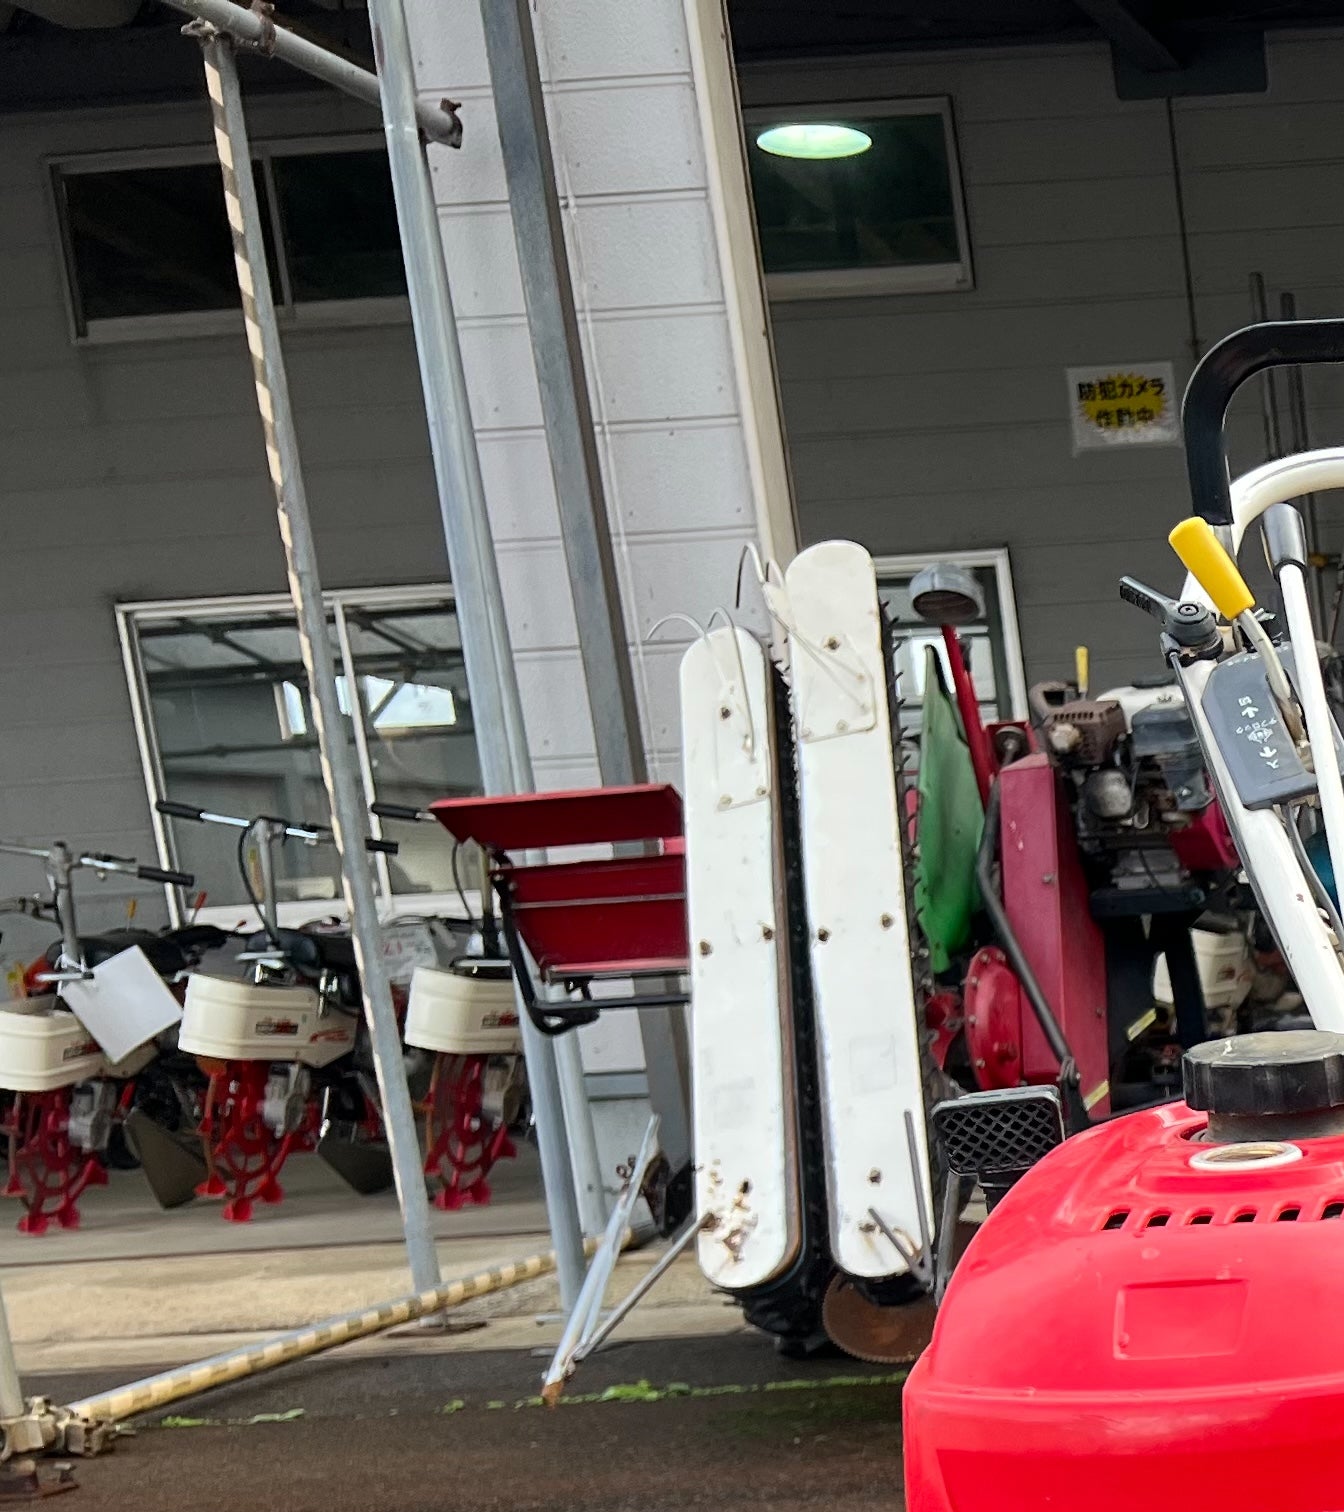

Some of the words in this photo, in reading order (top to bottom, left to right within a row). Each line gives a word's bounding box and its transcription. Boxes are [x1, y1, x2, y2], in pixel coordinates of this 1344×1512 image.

[1078, 377, 1166, 401] 防犯カメラ
